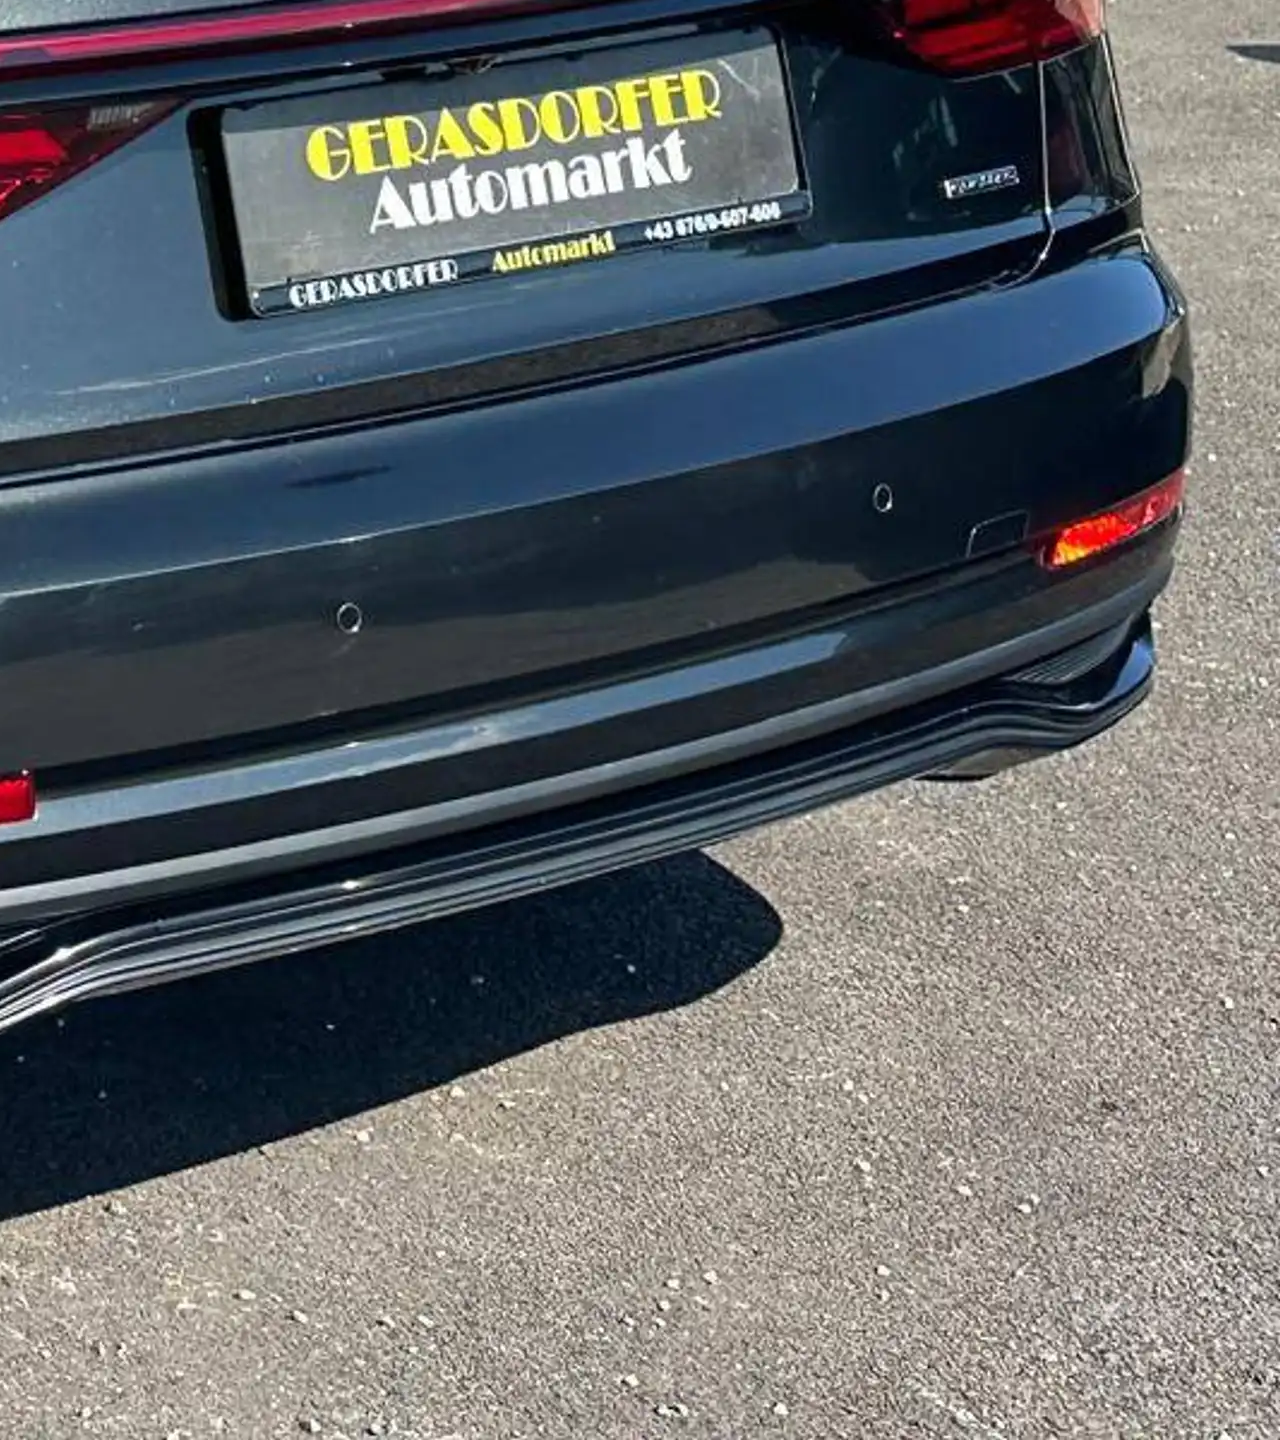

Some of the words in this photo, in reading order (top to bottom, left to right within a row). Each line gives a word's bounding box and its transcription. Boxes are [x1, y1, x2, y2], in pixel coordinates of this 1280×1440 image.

[306, 69, 723, 181] GERASDORFER
[370, 128, 693, 235] Automarkt
[288, 258, 459, 309] GERASDORFER
[491, 229, 617, 273] Automarkt
